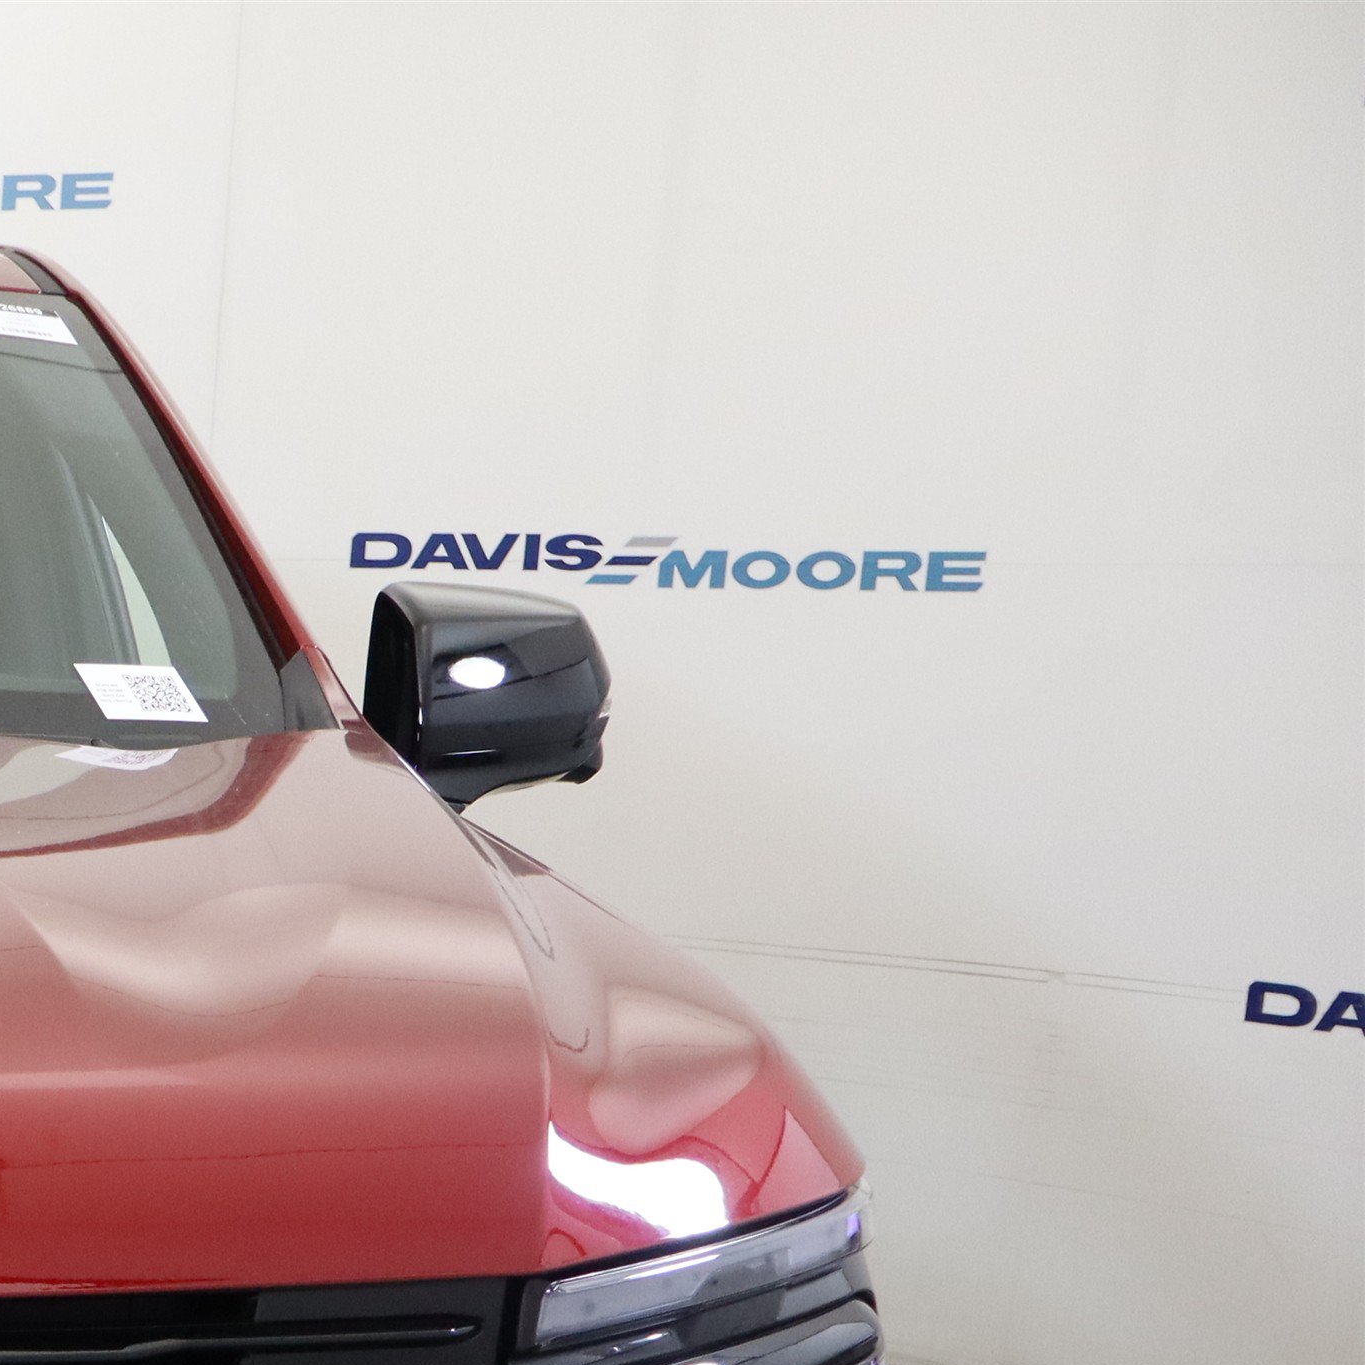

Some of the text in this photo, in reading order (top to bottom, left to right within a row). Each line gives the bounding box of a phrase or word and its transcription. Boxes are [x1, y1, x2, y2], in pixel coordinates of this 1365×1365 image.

[350, 532, 987, 592] DAVIS MOORE
[1244, 980, 1365, 1037] DA
